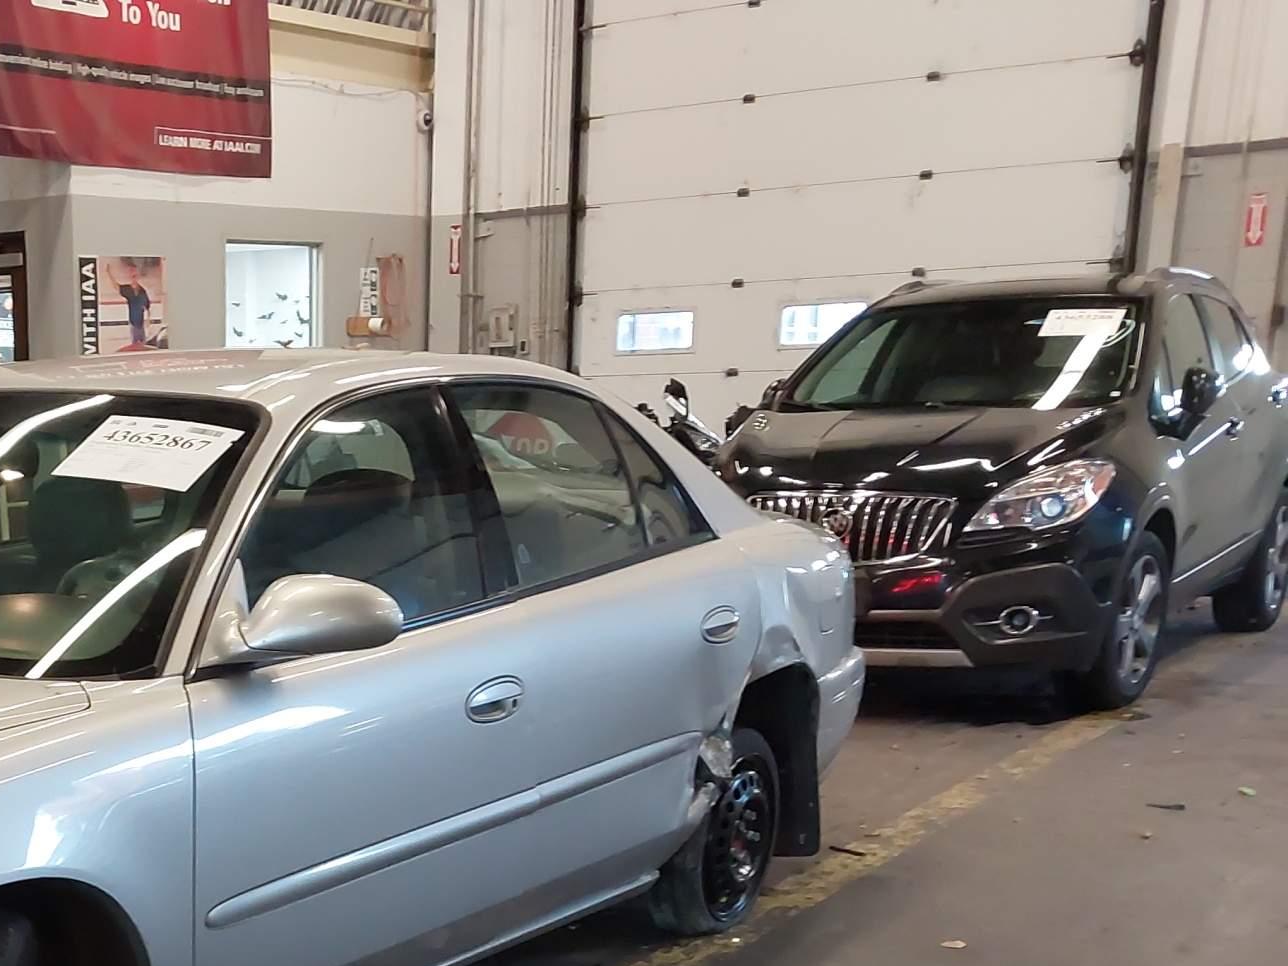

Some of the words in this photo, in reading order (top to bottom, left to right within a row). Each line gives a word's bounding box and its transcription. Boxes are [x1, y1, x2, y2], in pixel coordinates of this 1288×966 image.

[121, 0, 141, 24] To
[147, 1, 181, 31] You
[158, 133, 188, 148] LEARN
[82, 262, 96, 301] IAA
[103, 429, 212, 452] 43652867
